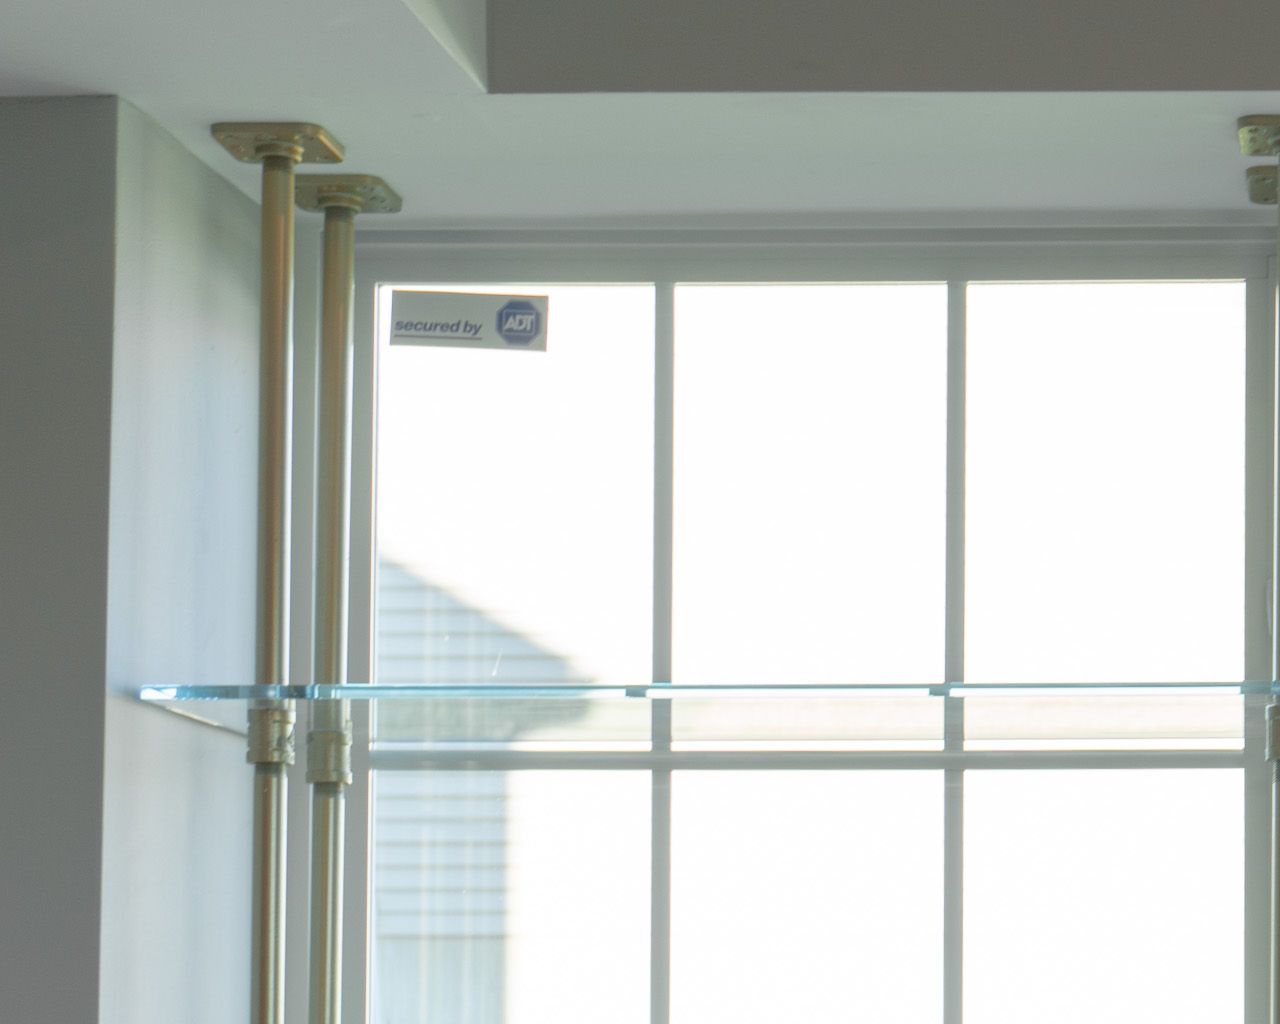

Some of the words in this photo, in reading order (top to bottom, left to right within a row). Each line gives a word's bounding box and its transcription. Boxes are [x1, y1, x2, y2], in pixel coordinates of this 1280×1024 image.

[395, 320, 461, 333] secured
[463, 320, 482, 336] by
[504, 315, 535, 331] ADT
